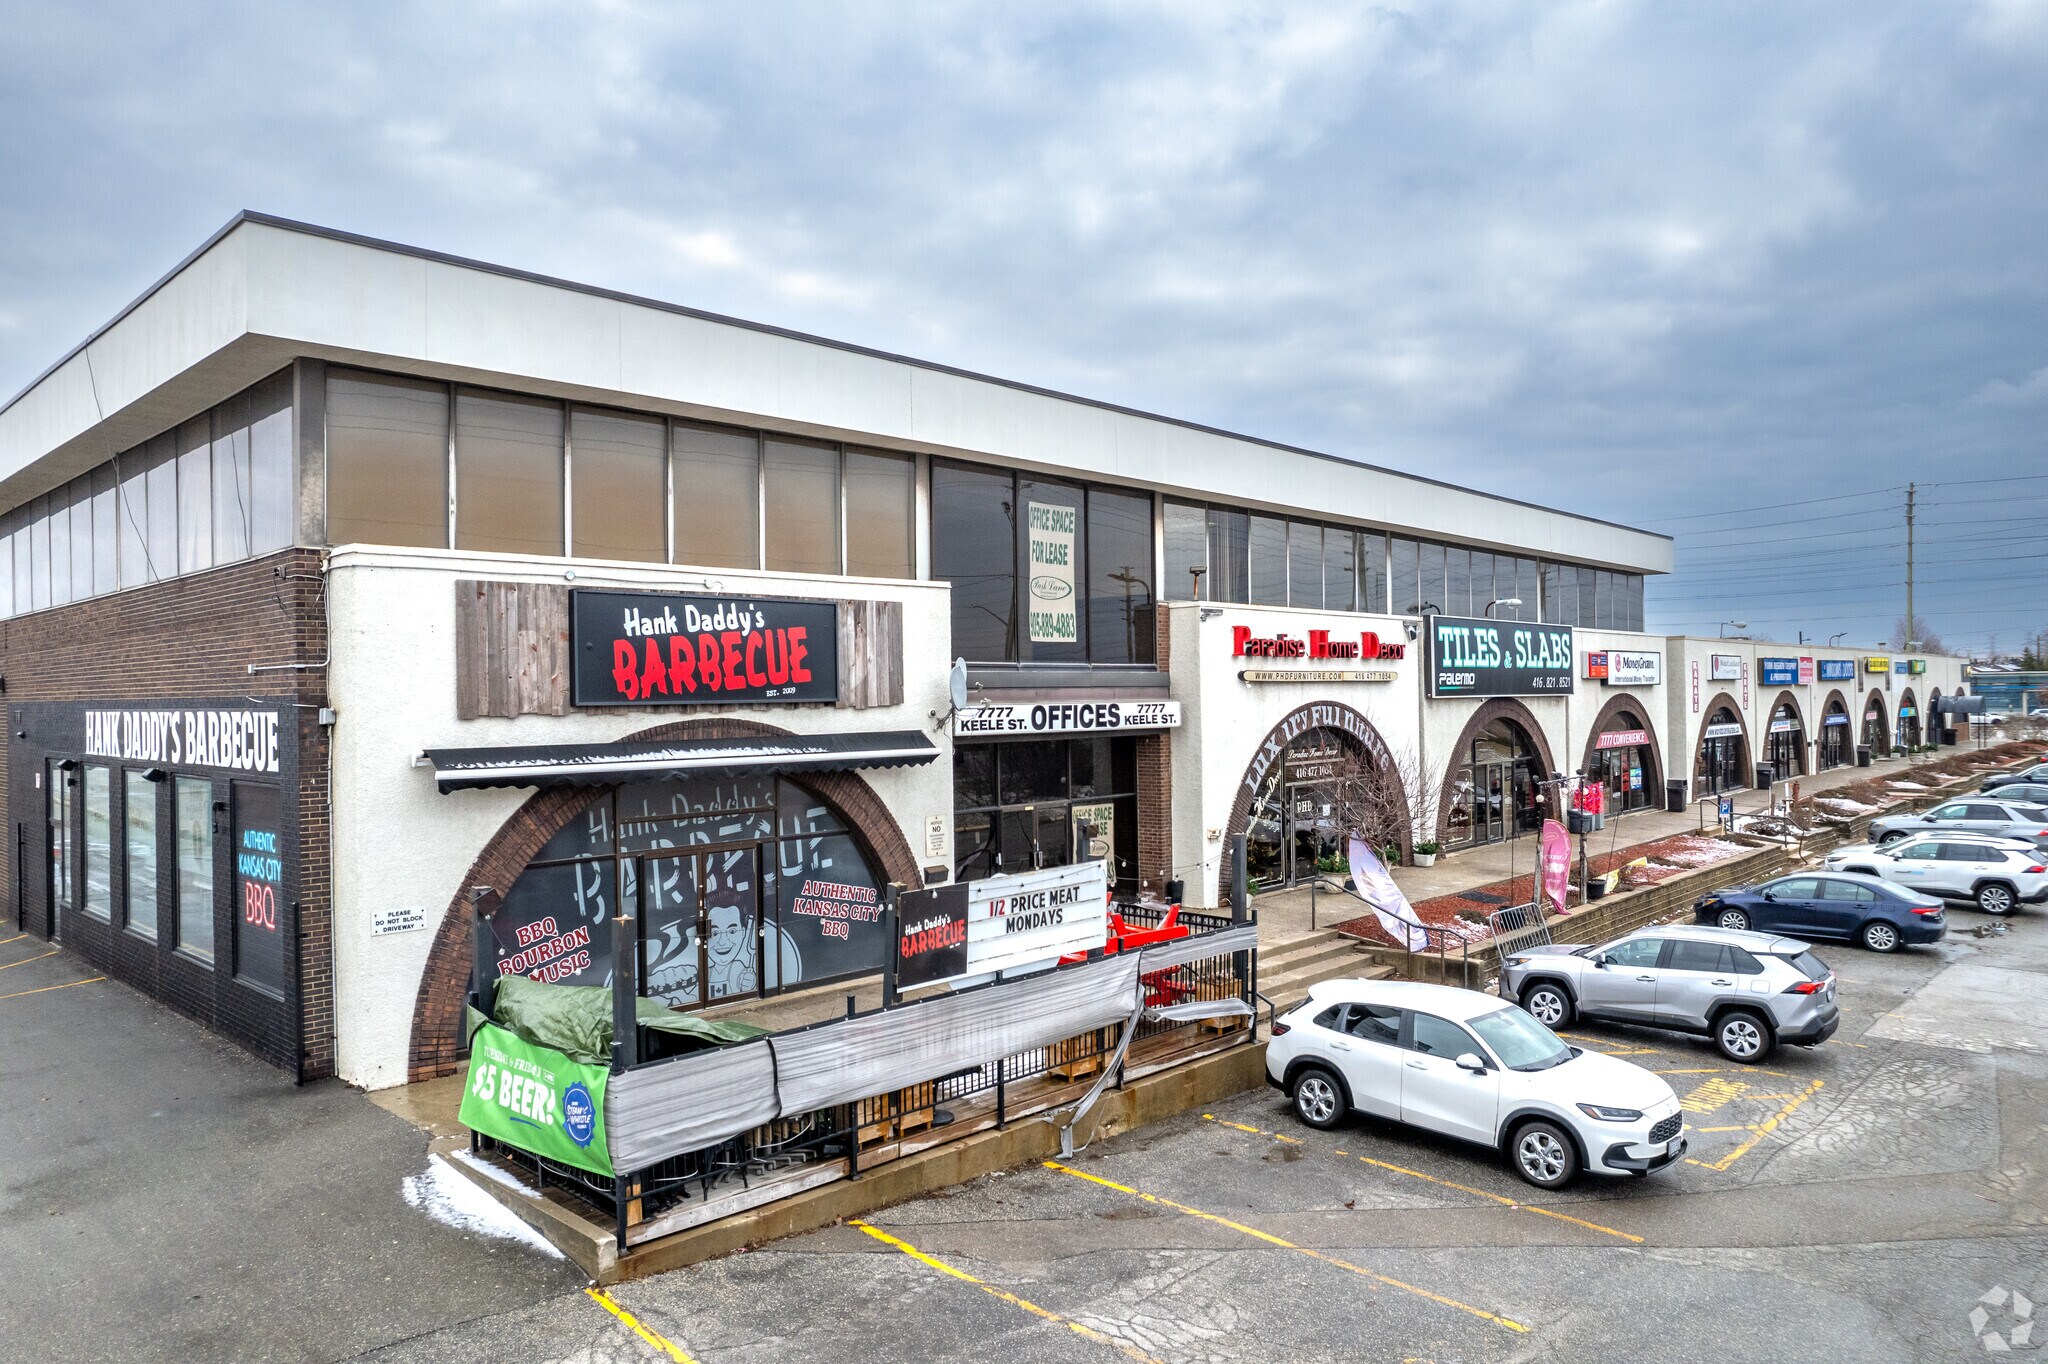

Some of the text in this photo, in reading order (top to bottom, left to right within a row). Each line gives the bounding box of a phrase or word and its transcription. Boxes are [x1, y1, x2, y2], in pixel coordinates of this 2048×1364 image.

[1030, 506, 1074, 533] OFFICE SPACE
[1032, 540, 1068, 566] FOR LEASE
[624, 602, 765, 636] Hank Daddy's
[1030, 612, 1075, 638] 905-889-4883
[1232, 626, 1406, 660] Paradise Home Decor
[1438, 626, 1500, 668] TILES
[1504, 650, 1512, 668] &
[1514, 630, 1571, 669] SLABS
[612, 627, 812, 700] BARBECUE
[1255, 672, 1342, 680] WWW.PHDFURNITURE.COM
[1622, 657, 1654, 671] MoneyGram
[766, 686, 796, 698] EST. 2009
[978, 706, 1013, 718] 7777
[1031, 704, 1120, 730] OFFICES
[1124, 714, 1176, 726] KEELE ST.
[1137, 704, 1165, 713] 7777
[961, 718, 1027, 732] KEELE ST.
[86, 711, 279, 772] HANK DADDY'S BARBECUE
[1601, 733, 1644, 746] 7777 CONVENIENCE
[1296, 768, 1306, 778] 416
[1307, 766, 1317, 777] 477
[588, 783, 774, 843] Hank Daddy's
[1094, 807, 1112, 821] SPACE
[244, 830, 276, 853] AUTHENTIC
[239, 853, 282, 882] KANSAS CITY
[574, 806, 833, 925] BARBECUE
[801, 880, 876, 903] AUTHENTIC
[990, 886, 1080, 918] 1/2 PRICE MEAT
[246, 882, 275, 929] BBQ
[793, 898, 881, 922] KANSAS CITY
[383, 924, 414, 932] DRIVEWAY
[516, 916, 558, 947] BBQ
[822, 920, 849, 940] BBQ
[905, 914, 950, 936] Hank Daddy's
[1006, 908, 1063, 934] MONDAYS
[901, 918, 966, 958] BARBECUE
[497, 926, 590, 977] BOURBON
[528, 950, 590, 984] MUSIC
[484, 1046, 508, 1065] TUESDAY
[514, 1058, 542, 1078] FRIDAY
[472, 1062, 556, 1125] $5 BEER!
